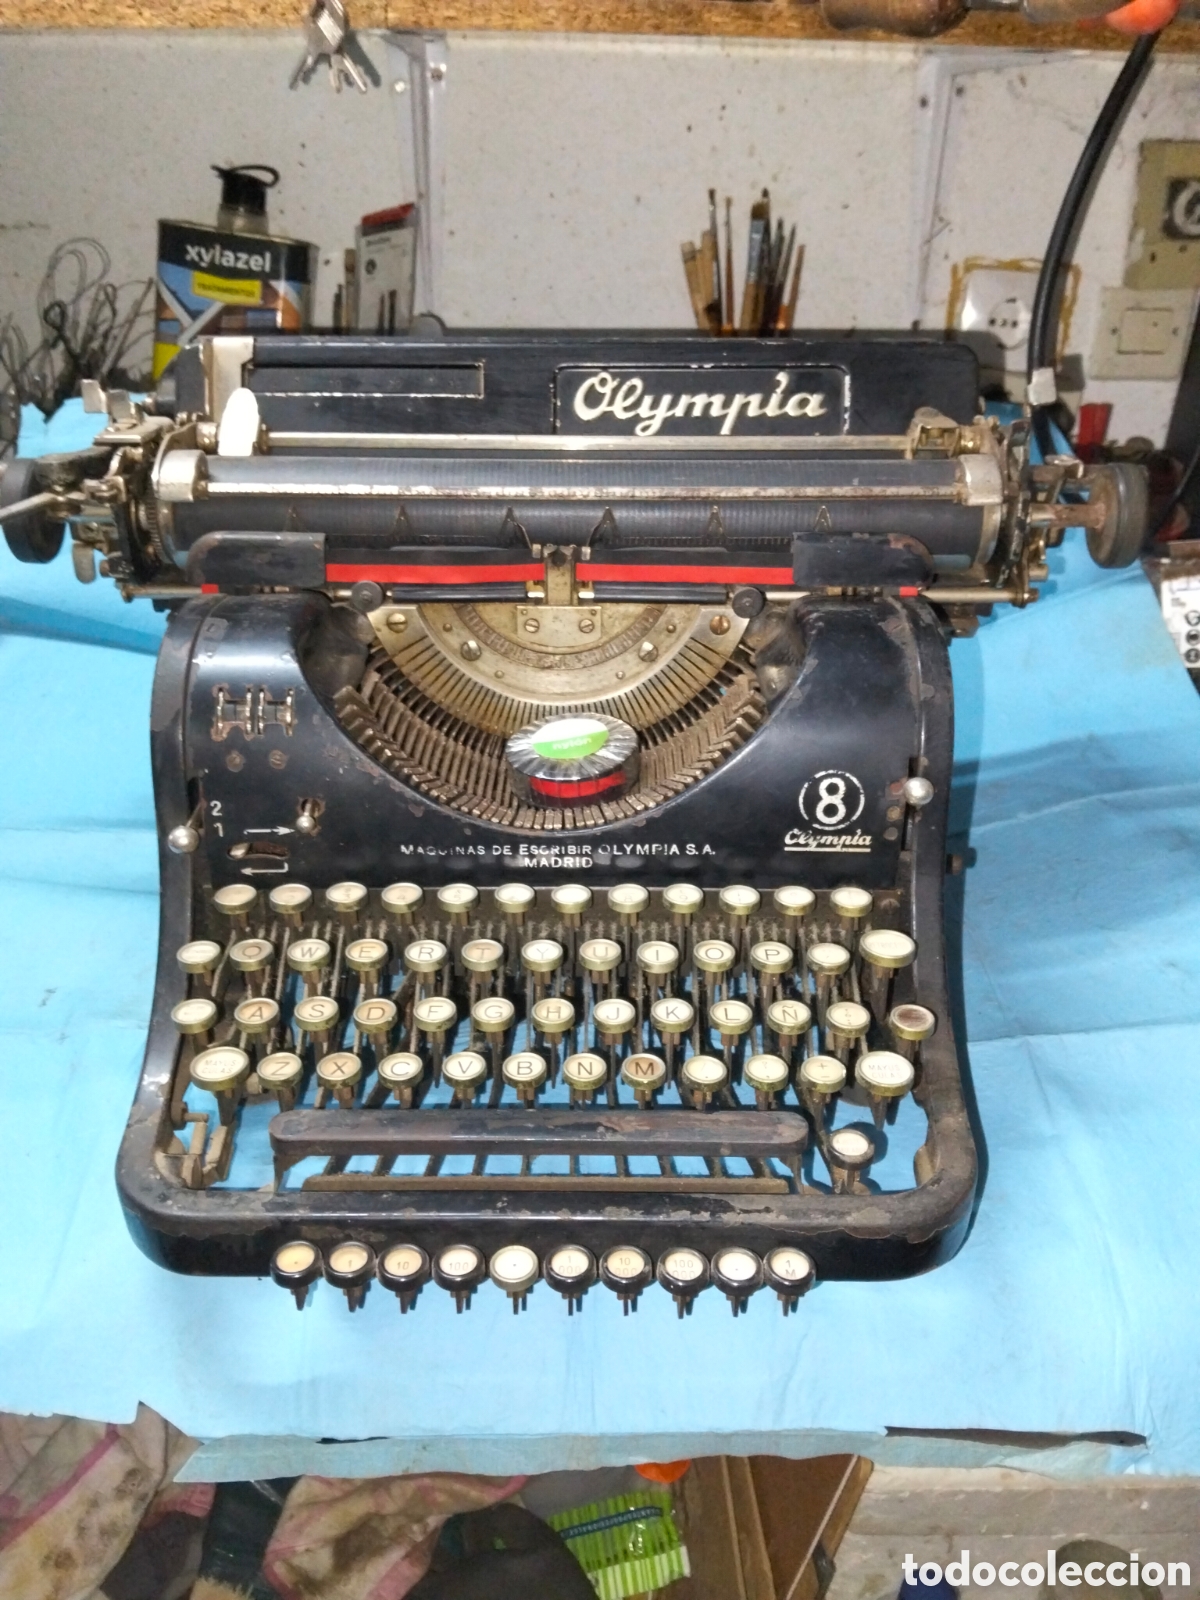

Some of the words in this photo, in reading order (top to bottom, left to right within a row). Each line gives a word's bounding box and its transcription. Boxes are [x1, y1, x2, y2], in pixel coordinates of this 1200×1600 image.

[185, 244, 271, 273] xylazel
[574, 371, 828, 436] Olympia
[815, 777, 847, 825] 8
[210, 801, 223, 817] 2
[213, 823, 224, 838] 1
[784, 828, 872, 849] Olympia
[492, 844, 513, 856] DE
[519, 843, 593, 856] ESCRIBIR
[598, 843, 681, 856] OLYMPIA
[524, 857, 593, 869] MADRID
[300, 947, 321, 959] W
[358, 946, 377, 959] E
[417, 946, 434, 960] R
[475, 947, 492, 961] T
[536, 947, 550, 960] Y
[592, 946, 609, 959] U
[704, 947, 724, 960] O
[764, 948, 780, 961] P
[247, 1006, 264, 1020] A
[308, 1004, 325, 1018] S
[366, 1006, 386, 1020] D
[427, 1005, 443, 1018] F
[484, 1005, 503, 1018] G
[546, 1005, 562, 1019] H
[605, 1007, 620, 1020] J
[665, 1005, 680, 1019] K
[723, 1007, 740, 1021] L
[781, 1005, 799, 1023] Ñ
[271, 1061, 291, 1076] Z
[330, 1061, 348, 1075] X
[391, 1062, 411, 1076] C
[458, 1061, 473, 1074] V
[516, 1061, 533, 1075] B
[577, 1062, 593, 1076] N
[635, 1062, 655, 1075] M
[396, 1261, 410, 1270] 10
